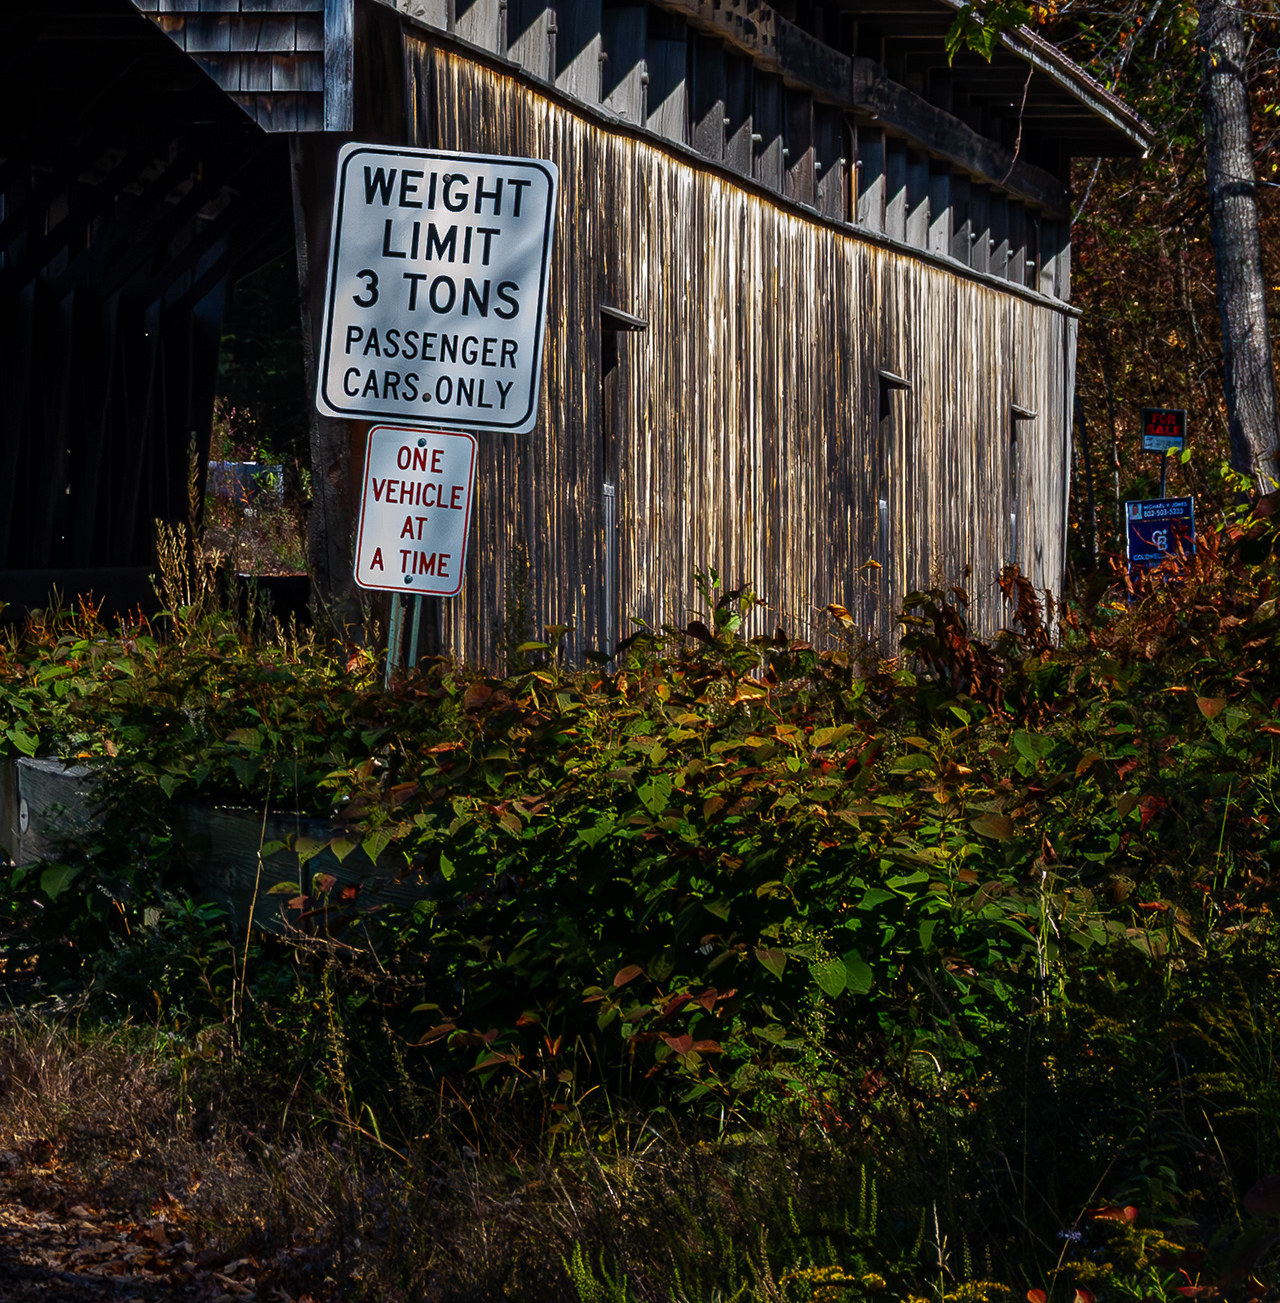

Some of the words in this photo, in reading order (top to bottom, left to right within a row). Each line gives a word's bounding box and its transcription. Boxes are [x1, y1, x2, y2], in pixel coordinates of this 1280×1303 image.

[364, 166, 531, 217] WEIGHT
[382, 219, 501, 266] LIMIT
[352, 268, 380, 308] 3
[403, 272, 520, 320] TONS
[345, 325, 519, 369] PASSENGER
[343, 367, 420, 402] CARS
[435, 375, 514, 410] ONLY
[1145, 424, 1181, 436] SALE
[1152, 412, 1176, 424] FOR
[397, 446, 444, 473] ONE
[372, 477, 464, 510] VEHICLE
[400, 516, 428, 540] AT
[370, 547, 384, 571] A
[400, 550, 451, 578] TIME
